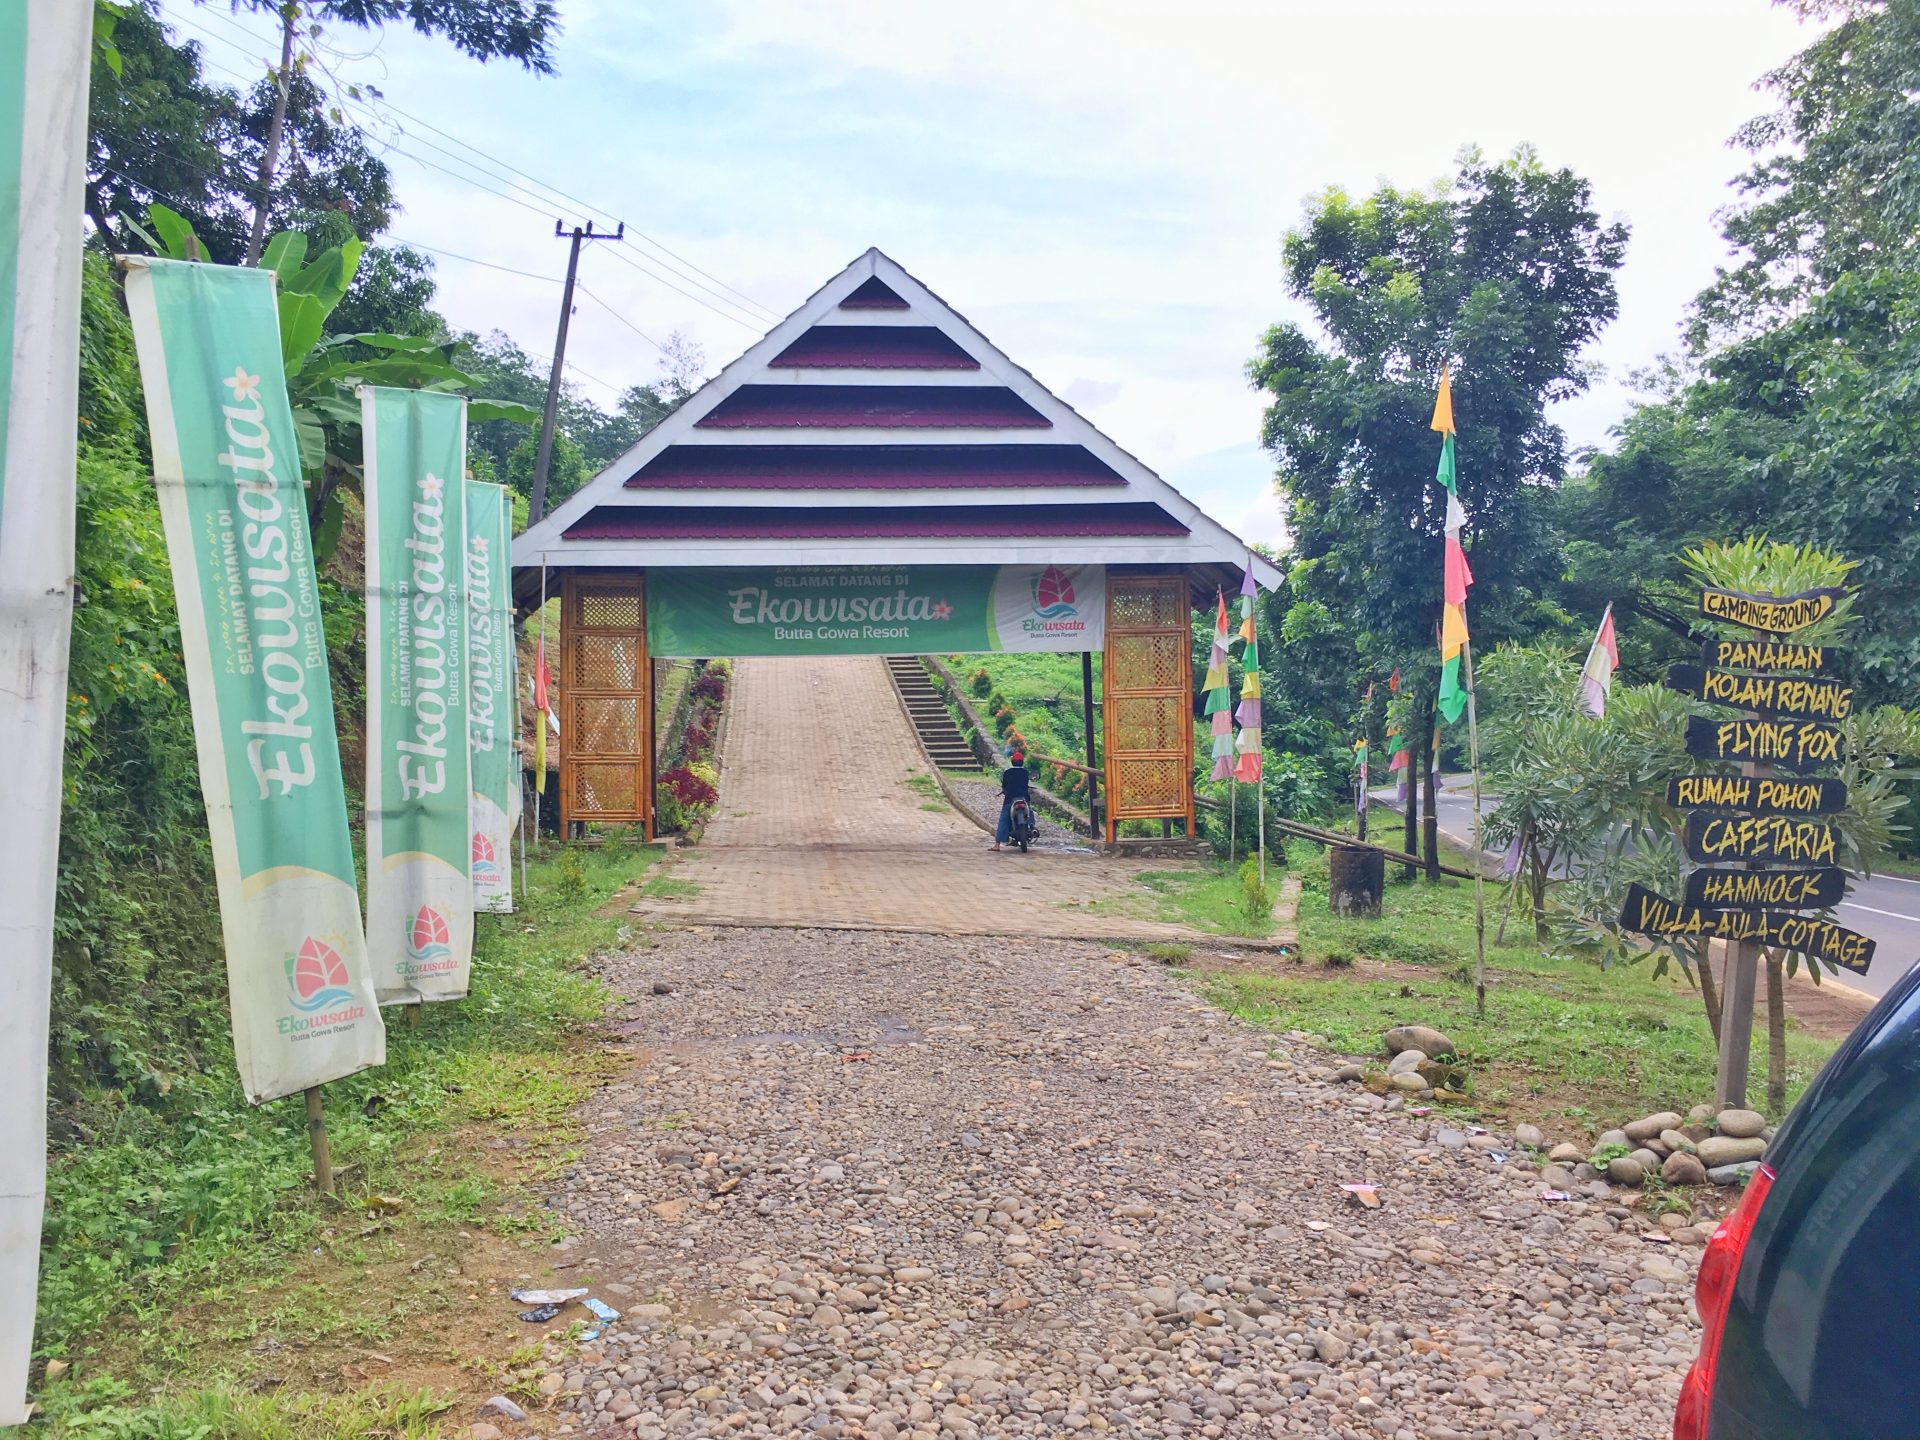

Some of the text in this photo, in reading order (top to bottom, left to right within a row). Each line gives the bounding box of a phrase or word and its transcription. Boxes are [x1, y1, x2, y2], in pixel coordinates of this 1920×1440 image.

[217, 509, 233, 527] DI
[221, 532, 243, 596] DATANG
[774, 574, 909, 587] SELAMAT DATANG DI
[218, 395, 316, 800] Ekowisata
[288, 506, 323, 669] Butta Gowa Resort
[728, 587, 937, 625] Ekowisata
[1022, 619, 1086, 631] Ekowisata
[1706, 594, 1822, 630] CAMPING GROUND
[231, 604, 255, 676] SELAMAT
[396, 497, 448, 801] Ekowisata
[398, 580, 412, 707] SELAMAT DATANG DI
[446, 583, 460, 706] Butta Gowa Resort
[774, 625, 910, 640] Butta Gowa Resort
[1717, 641, 1822, 670] PANAHAN
[1703, 670, 1853, 720] KOLAM RENANG
[1717, 721, 1842, 763] FLYING FOX
[1677, 777, 1823, 812] RUMAH POHON
[1701, 816, 1836, 864] CAFETARIA
[1703, 872, 1823, 905] HAMMOCK
[395, 960, 461, 975] Ekowisata
[276, 1006, 366, 1035] Ekowisata
